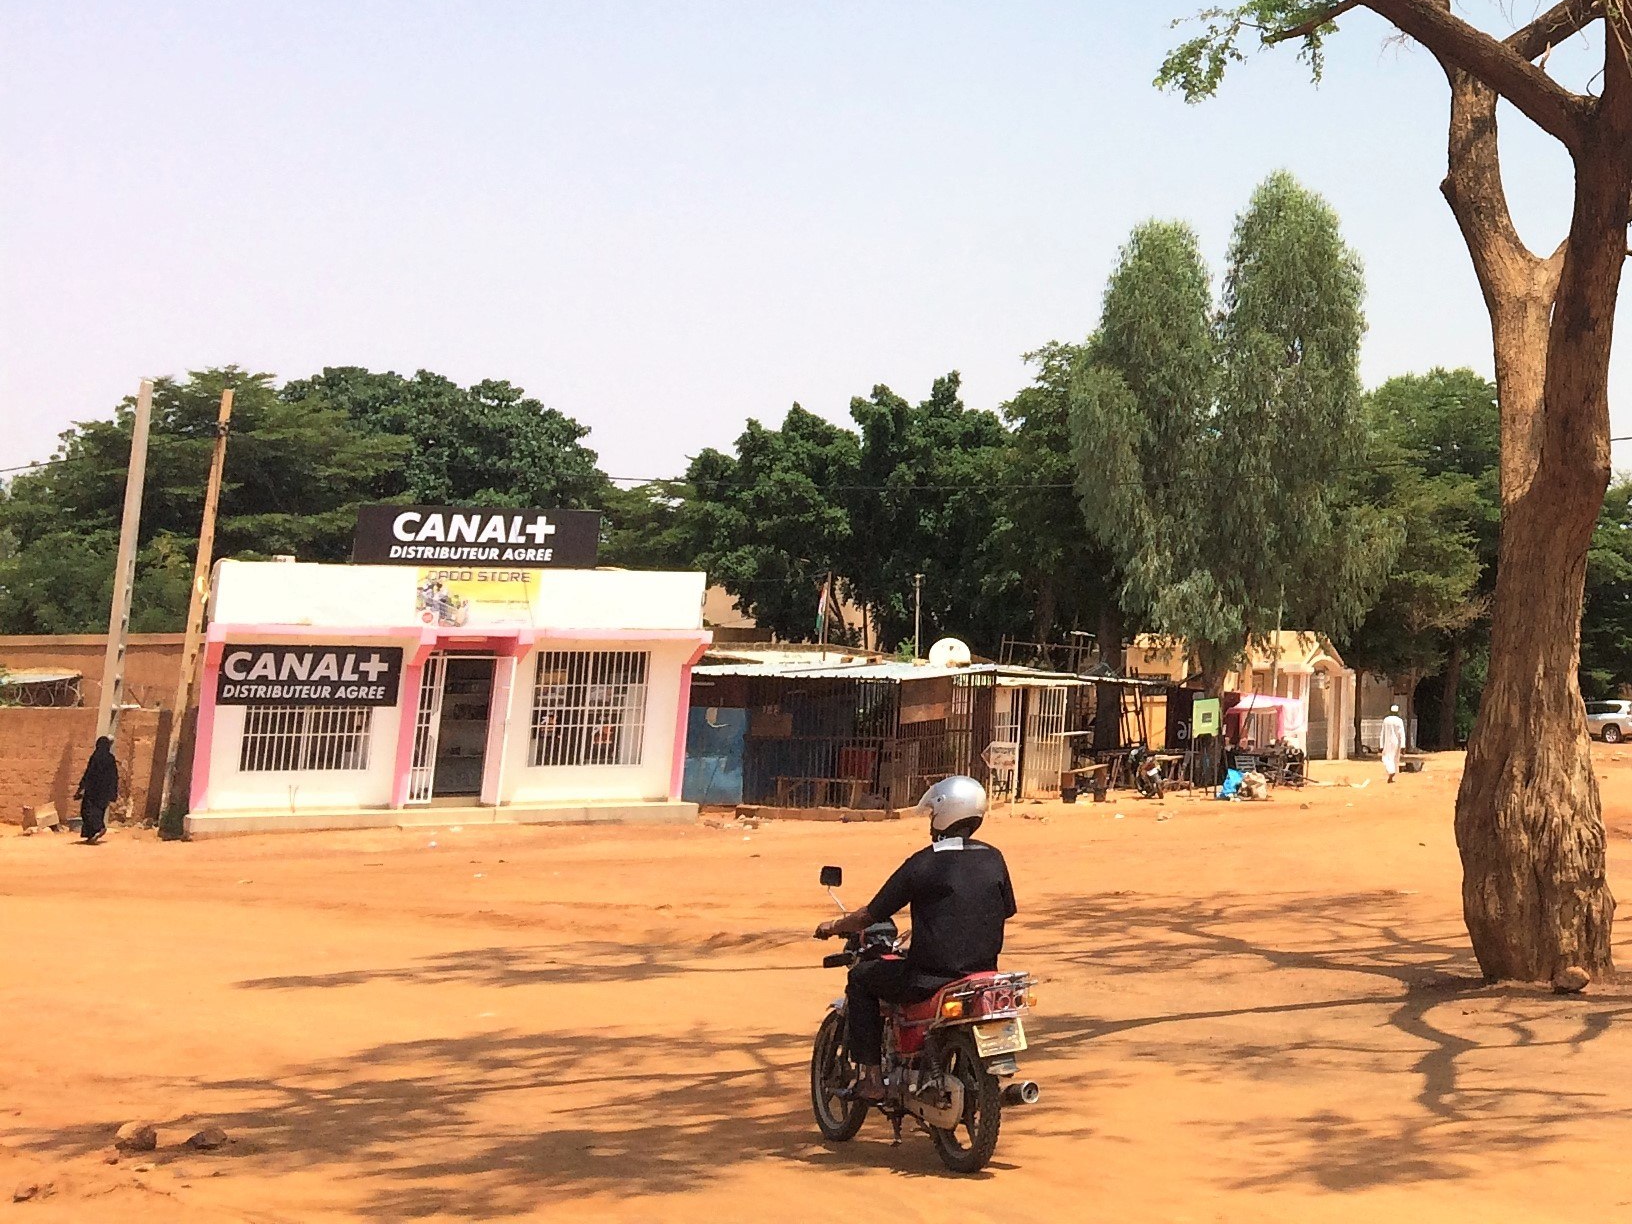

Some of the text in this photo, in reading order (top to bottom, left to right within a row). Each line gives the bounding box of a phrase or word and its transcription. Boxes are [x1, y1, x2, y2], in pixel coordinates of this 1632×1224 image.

[393, 511, 556, 544] CANAL+
[389, 545, 553, 561] DISTRIBUTEUR AGREE
[477, 571, 531, 583] STORE
[224, 651, 389, 682] CANAL+
[222, 684, 386, 700] DISTRIBUTEUR AGREE
